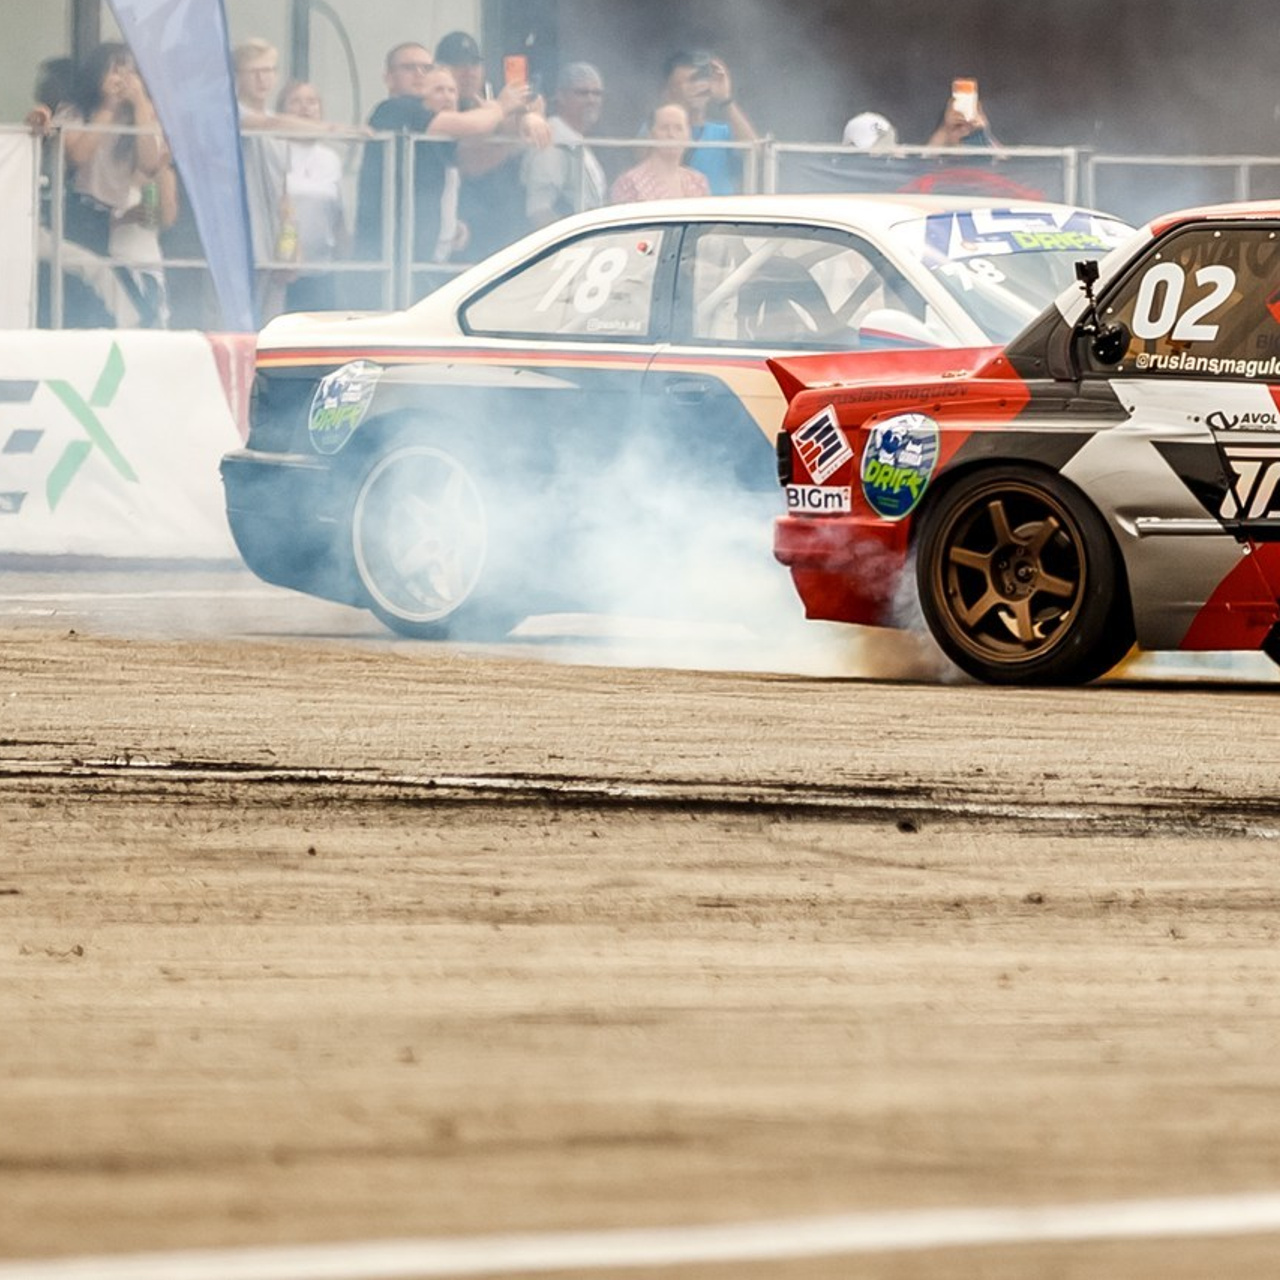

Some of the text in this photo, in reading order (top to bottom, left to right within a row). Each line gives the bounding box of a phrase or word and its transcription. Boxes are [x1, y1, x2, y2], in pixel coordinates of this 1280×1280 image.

[1131, 261, 1237, 342] 02
[1240, 412, 1278, 424] AVOL
[865, 459, 924, 500] DRIFT
